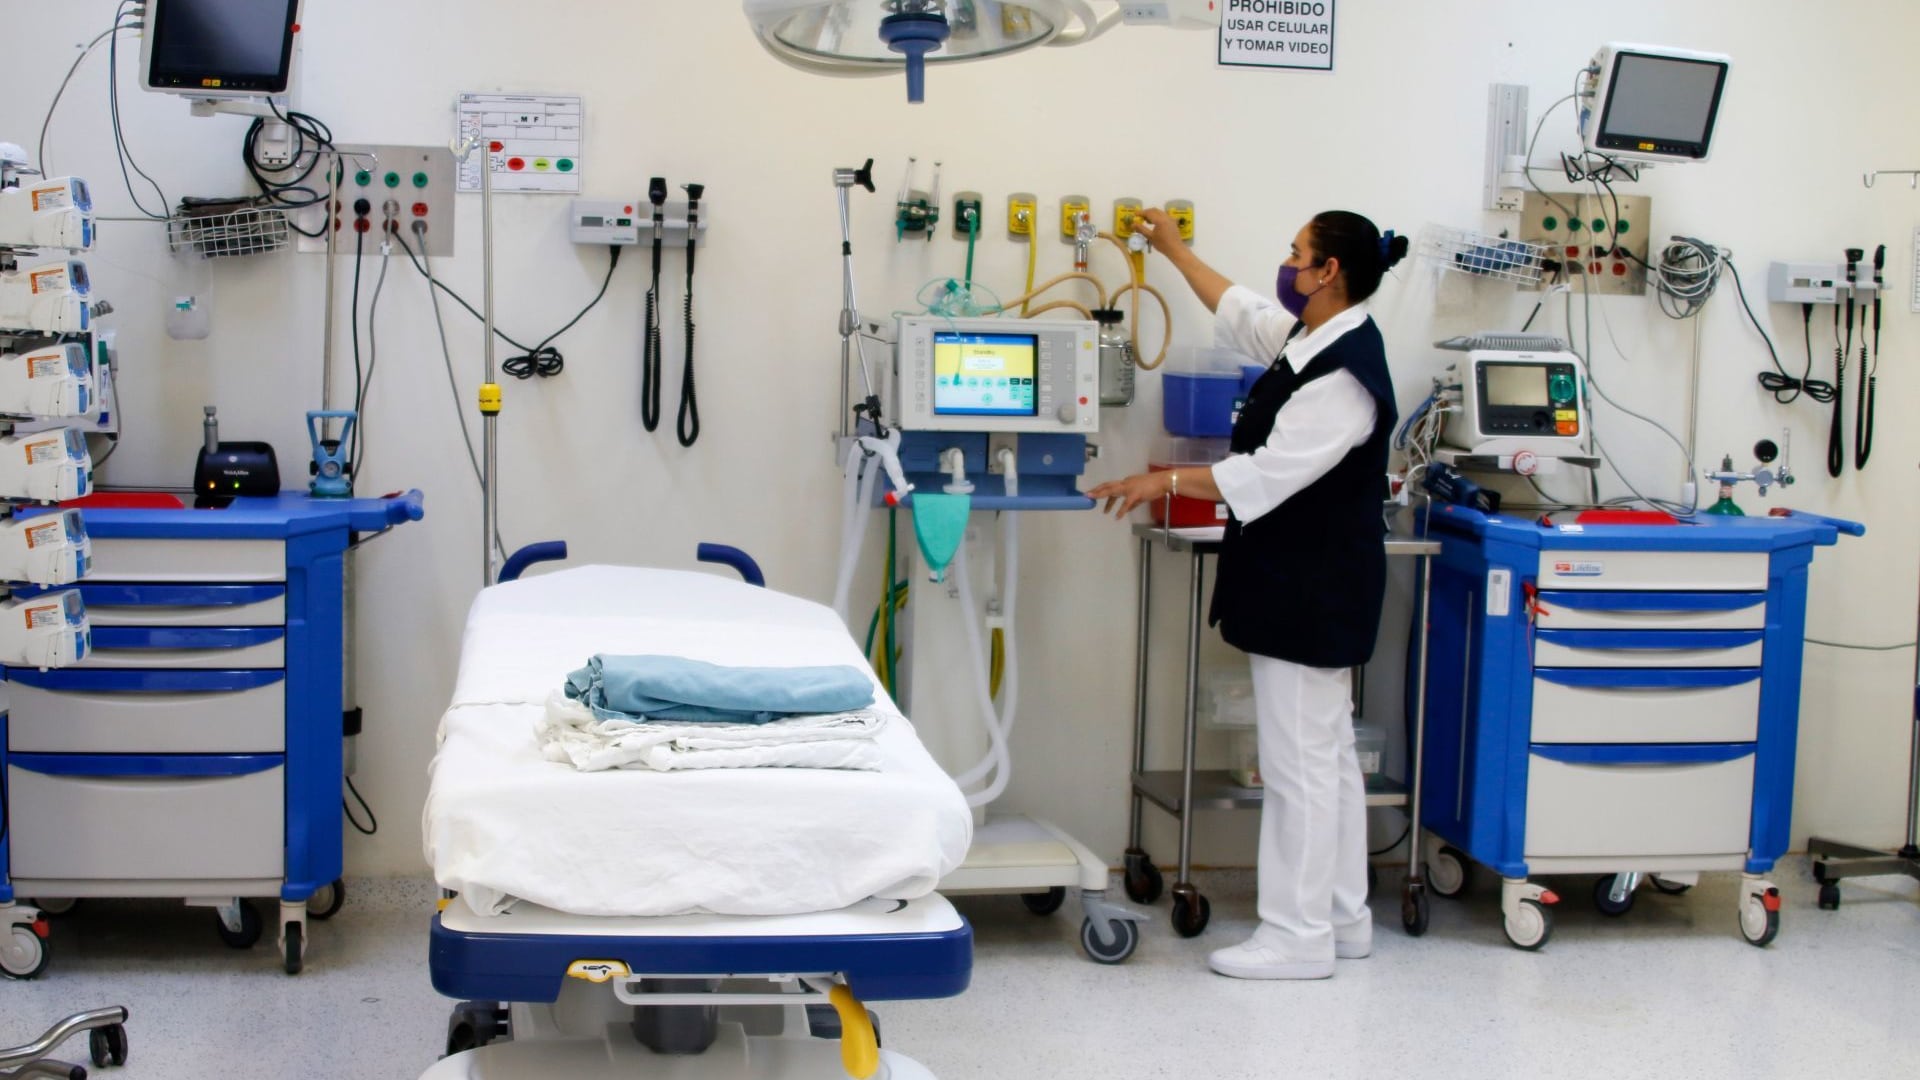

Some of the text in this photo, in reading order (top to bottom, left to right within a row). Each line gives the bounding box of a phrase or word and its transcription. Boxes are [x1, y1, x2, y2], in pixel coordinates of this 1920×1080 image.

[1229, 0, 1325, 16] PROHIBIDO
[1227, 19, 1329, 35] USAR CELULAR
[1224, 38, 1329, 54] Y TOMAR VIDEO
